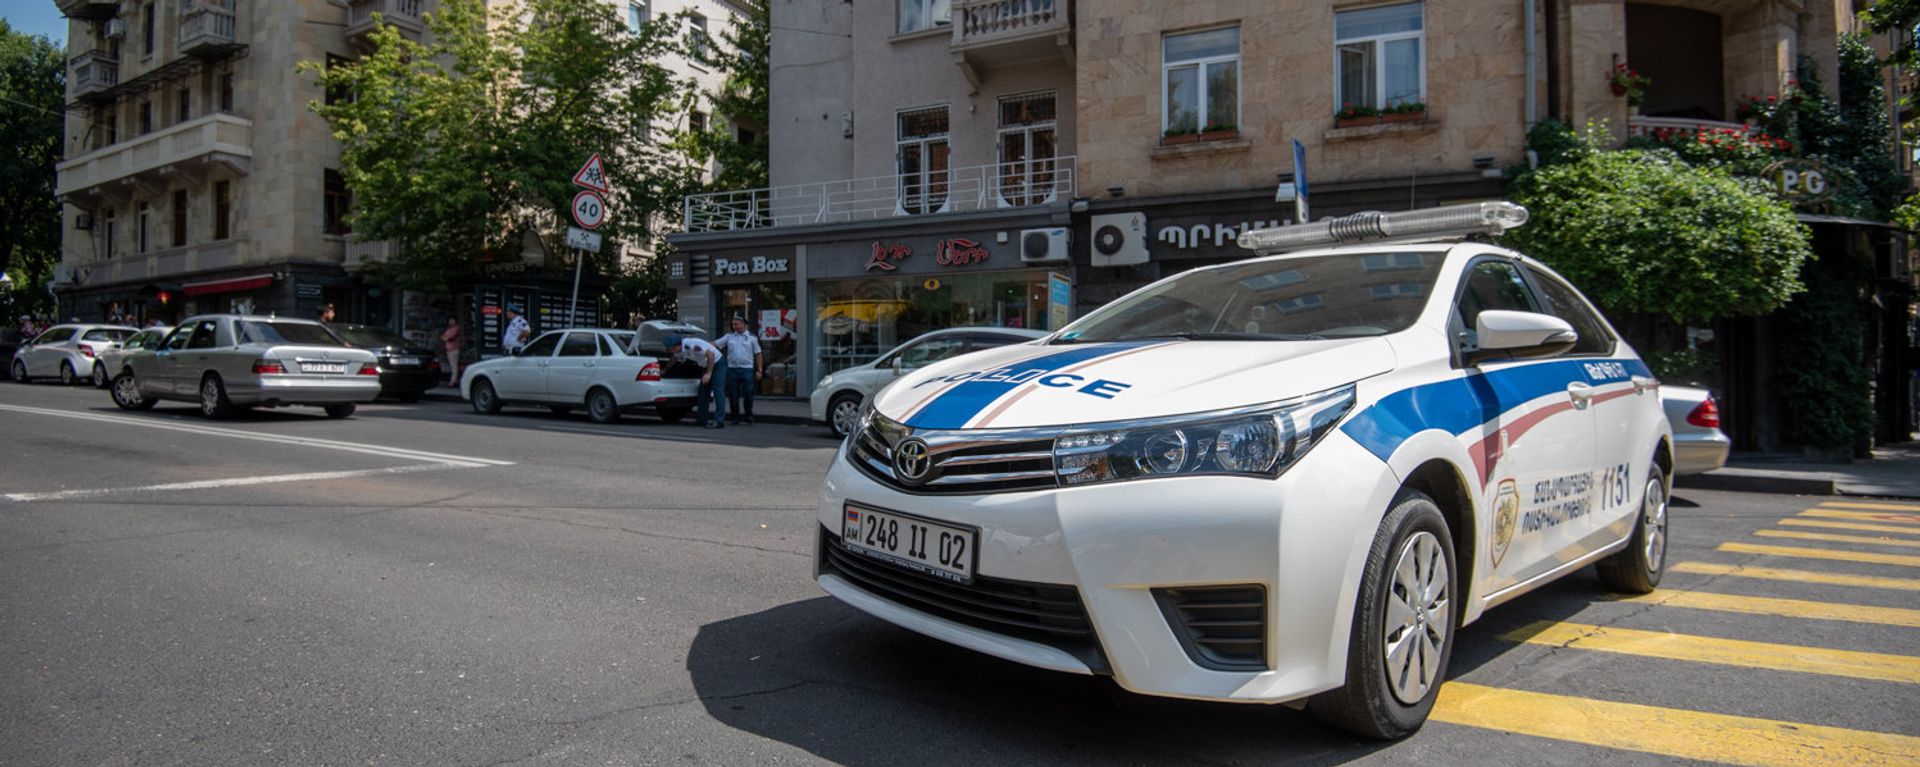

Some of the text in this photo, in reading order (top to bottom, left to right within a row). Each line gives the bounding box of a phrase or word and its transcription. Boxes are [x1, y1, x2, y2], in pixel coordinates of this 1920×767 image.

[579, 201, 599, 217] 40
[715, 255, 788, 275] Pen Box
[912, 368, 1133, 400] POLICE
[1602, 462, 1630, 510] 1151
[846, 527, 858, 541] AM
[865, 514, 899, 552] 248
[938, 531, 967, 570] 02
